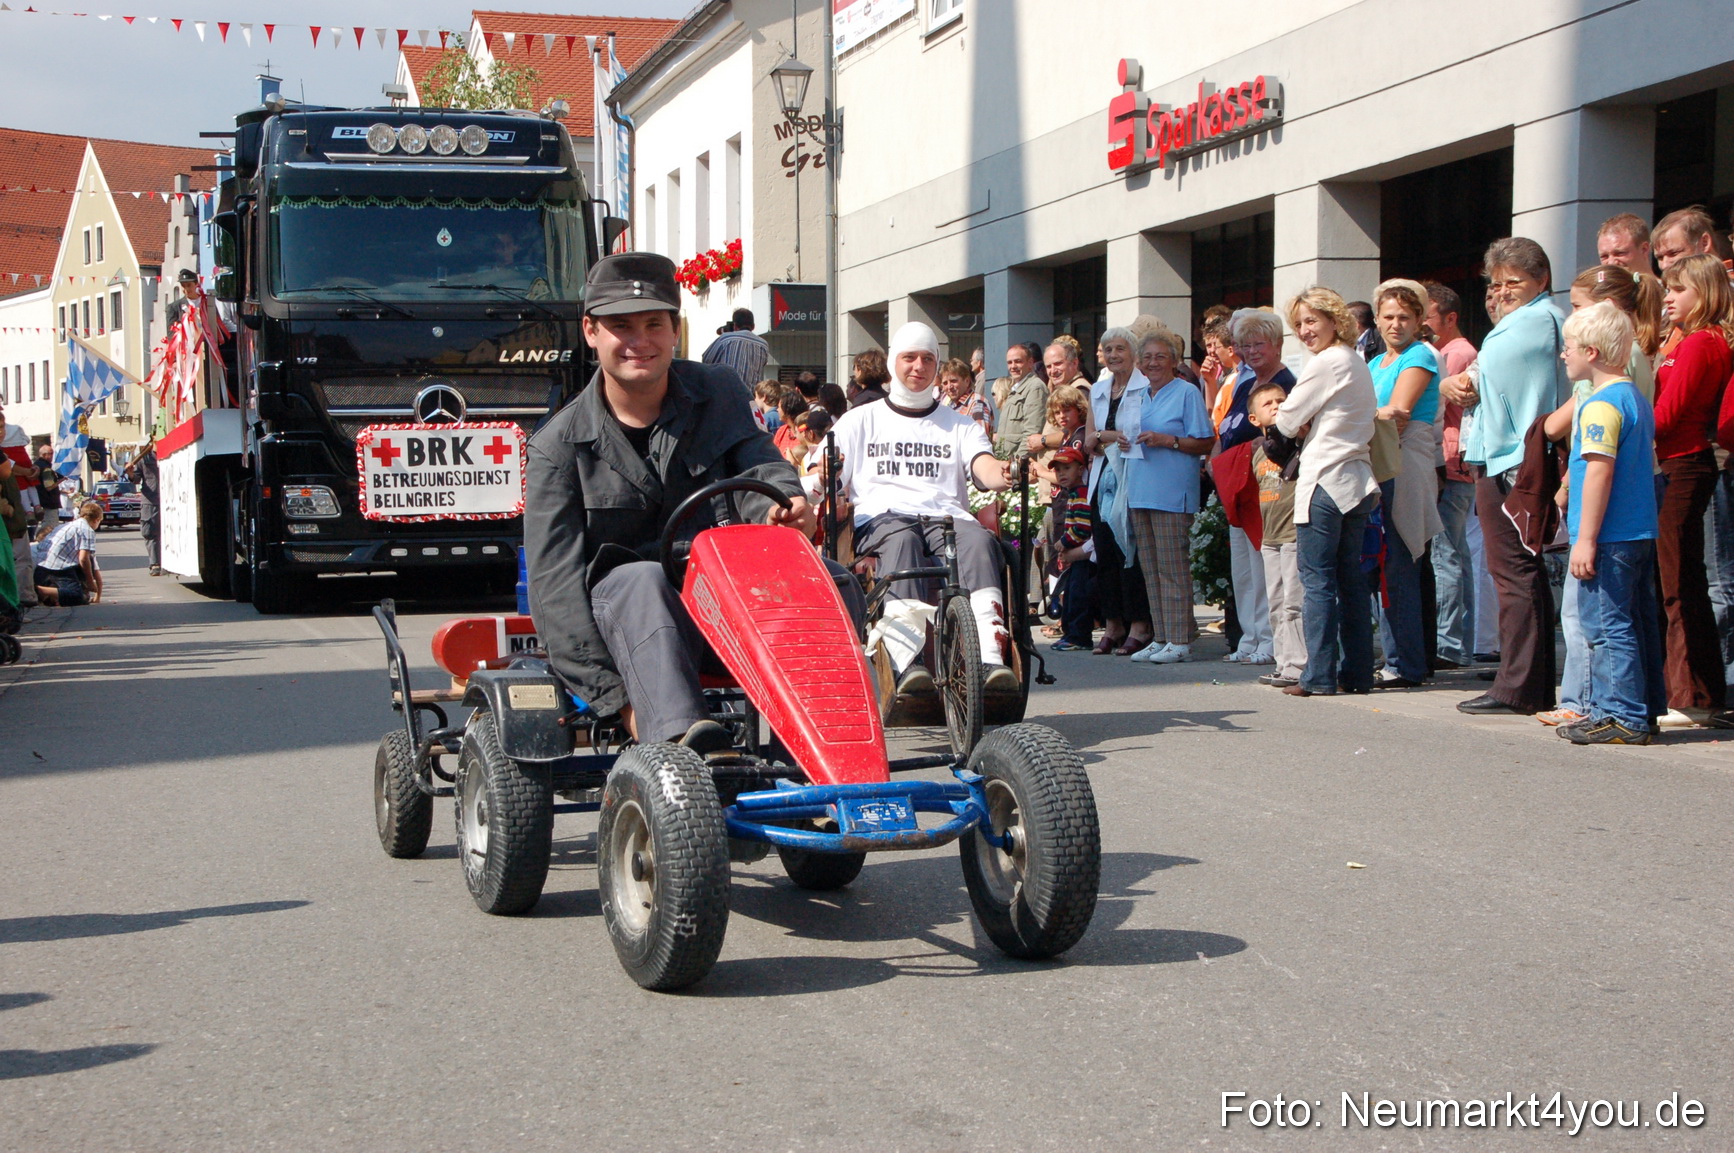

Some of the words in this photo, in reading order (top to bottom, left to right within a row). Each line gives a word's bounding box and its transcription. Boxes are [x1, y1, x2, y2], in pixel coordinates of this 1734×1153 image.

[1146, 75, 1268, 169] Sparkasse
[778, 310, 807, 321] Mode
[809, 310, 822, 321] für
[296, 356, 318, 365] V8
[498, 349, 573, 363] LANGE
[407, 435, 475, 467] BRK
[867, 442, 890, 460] EIN
[894, 441, 952, 460] SCHUSS
[876, 461, 901, 478] EIN
[905, 460, 941, 478] TOR!
[373, 469, 511, 489] BETREUUNGSDIENST
[373, 491, 456, 509] BEILNGRIES
